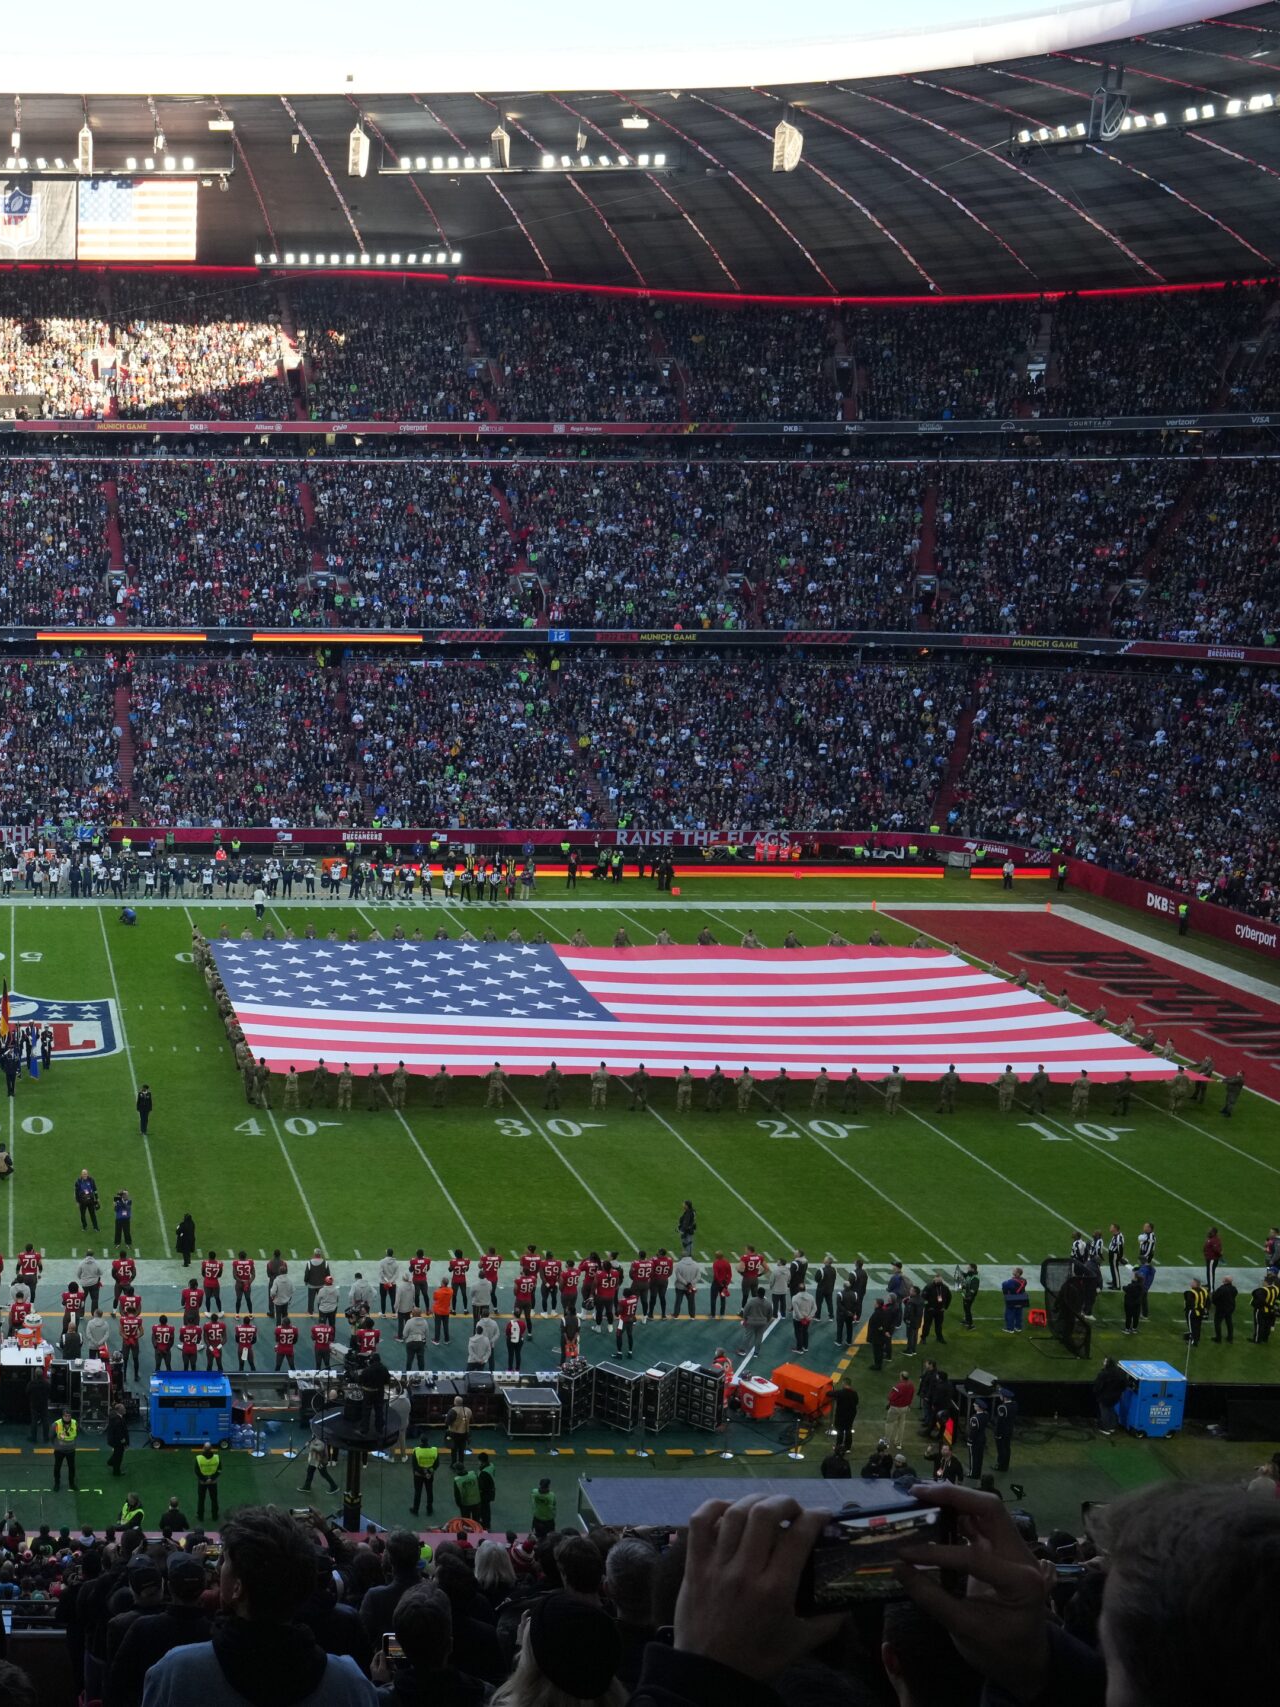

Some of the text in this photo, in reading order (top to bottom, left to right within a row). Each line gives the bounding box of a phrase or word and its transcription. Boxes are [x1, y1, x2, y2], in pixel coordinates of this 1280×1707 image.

[1166, 418, 1196, 427] verizon
[1251, 416, 1270, 424] VISA
[189, 423, 204, 431] DKB
[254, 423, 274, 431] Allianz
[640, 633, 671, 641] MUNICH
[673, 633, 697, 641] GAME
[1013, 640, 1050, 648] MUNICH
[1052, 641, 1078, 649] GAME
[1207, 649, 1245, 659] BUCCANEERS
[342, 832, 383, 841] BUCCANEERS
[616, 830, 673, 846] RAISE
[680, 831, 720, 847] THE
[1146, 892, 1169, 913] DKB
[1235, 924, 1277, 948] cyberport
[233, 1117, 319, 1137] 40
[494, 1118, 585, 1138] 30
[756, 1119, 849, 1140] 20
[1016, 1121, 1120, 1142] 10
[23, 1259, 36, 1268] 70
[486, 1261, 499, 1271] 79
[530, 1262, 536, 1271] 9
[748, 1261, 761, 1270] 94
[119, 1266, 132, 1276] 45
[205, 1268, 219, 1277] 57
[237, 1265, 250, 1275] 53
[415, 1265, 428, 1274] 54
[545, 1266, 559, 1276] 59
[638, 1268, 652, 1277] 92
[656, 1266, 669, 1274] 96
[567, 1277, 579, 1286] 90
[602, 1278, 616, 1288] 50
[67, 1299, 80, 1309] 29
[190, 1297, 196, 1306] 6
[15, 1311, 26, 1320] 13
[124, 1325, 138, 1335] 27
[208, 1329, 223, 1340] 35
[22, 1339, 29, 1347] G
[156, 1333, 170, 1343] 30
[184, 1334, 197, 1344] 24
[240, 1333, 254, 1343] 23
[280, 1334, 294, 1344] 32
[317, 1333, 329, 1343] 31
[364, 1338, 375, 1347] 14
[743, 1392, 754, 1409] G
